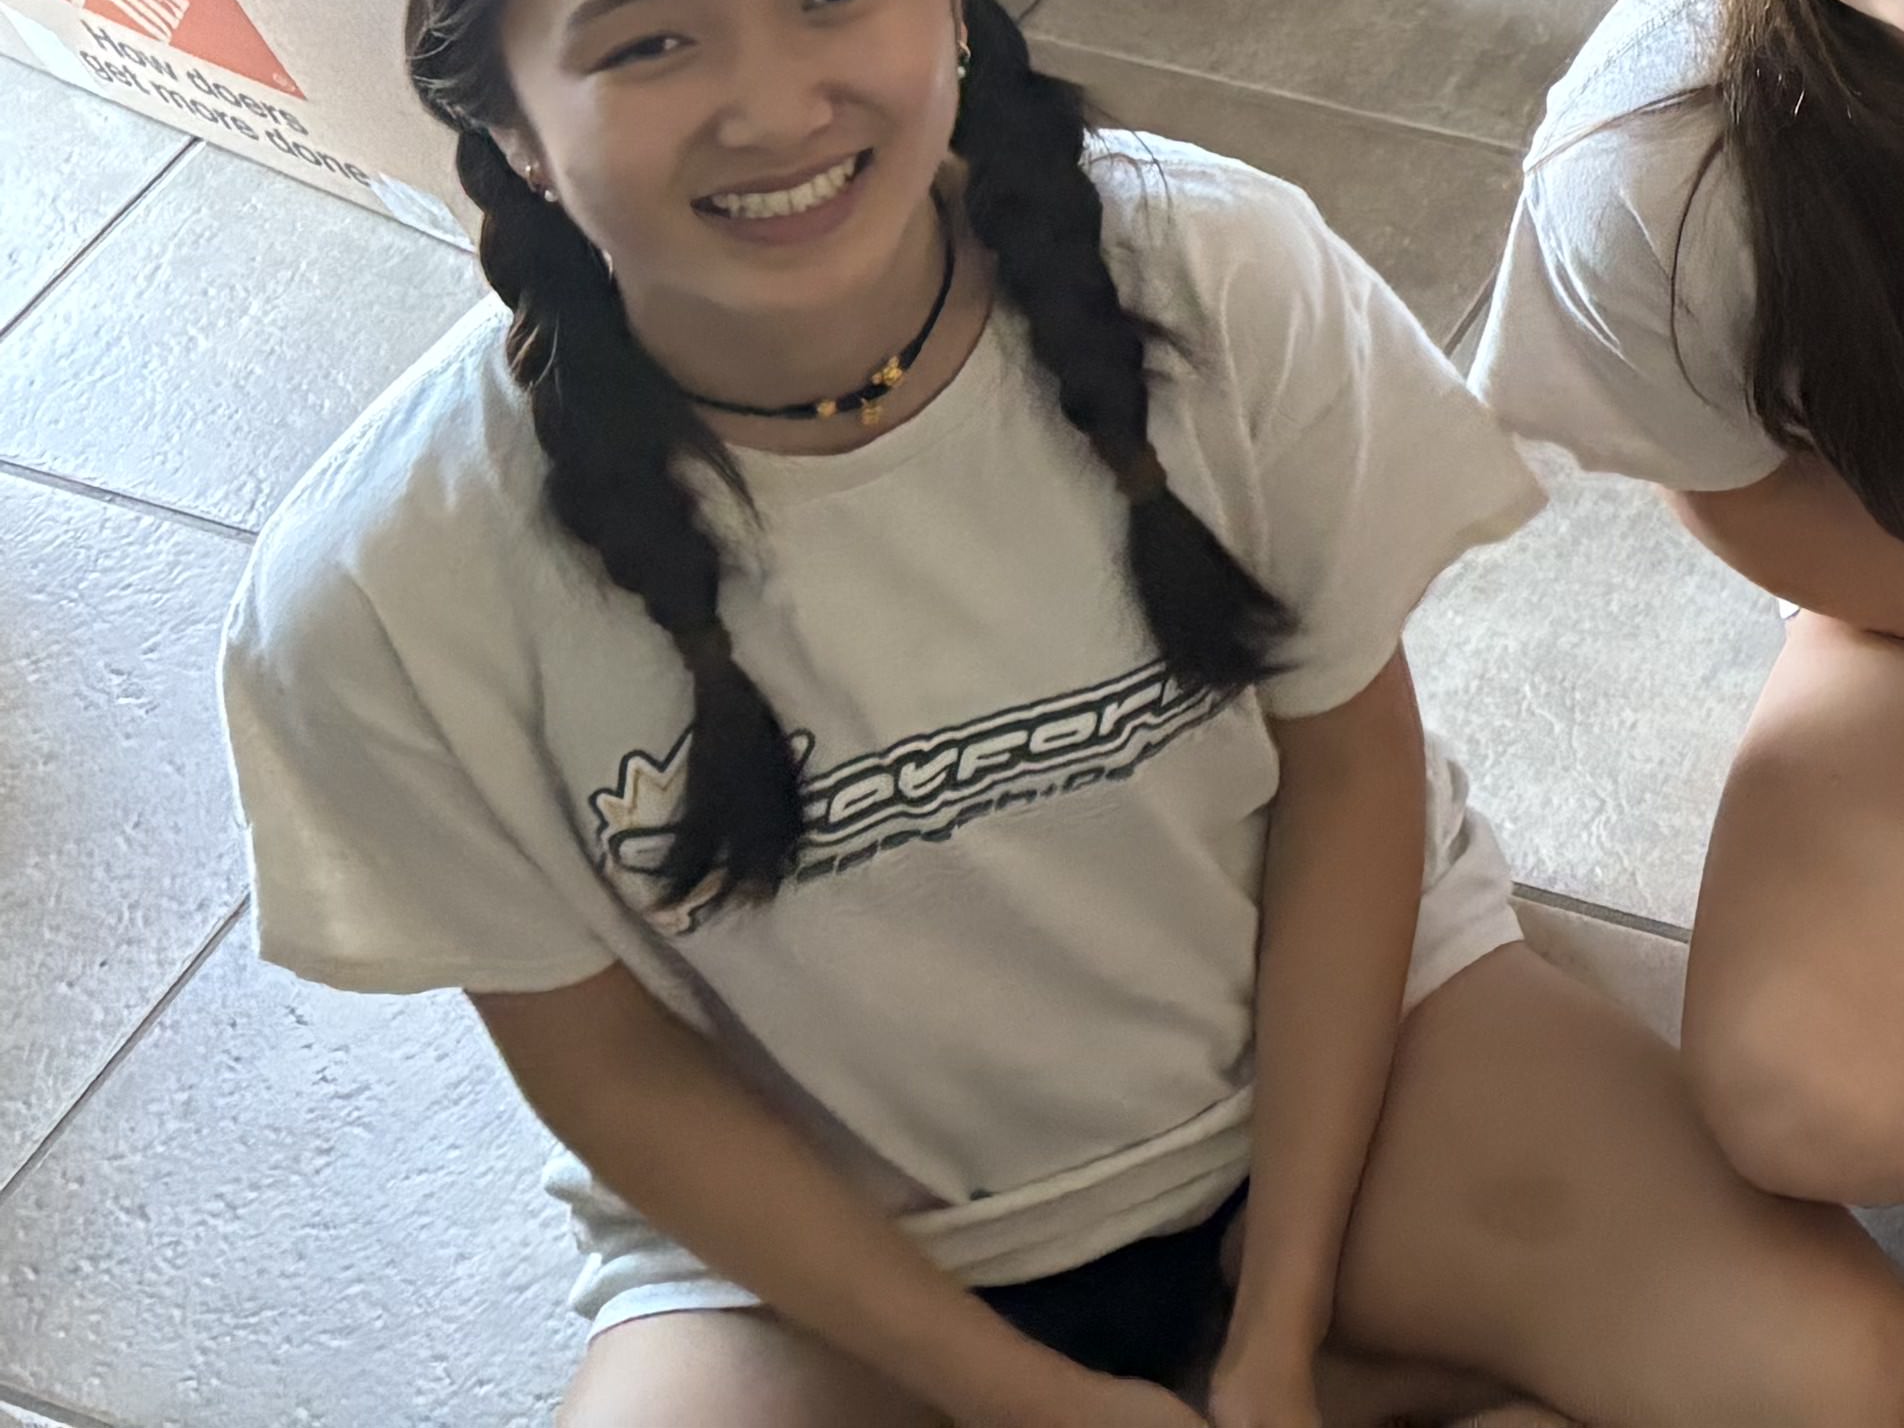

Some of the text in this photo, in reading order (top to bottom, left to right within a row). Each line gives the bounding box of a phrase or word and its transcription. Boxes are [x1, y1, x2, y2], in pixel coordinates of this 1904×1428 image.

[79, 50, 372, 188] get more done
[80, 19, 310, 138] How doers
